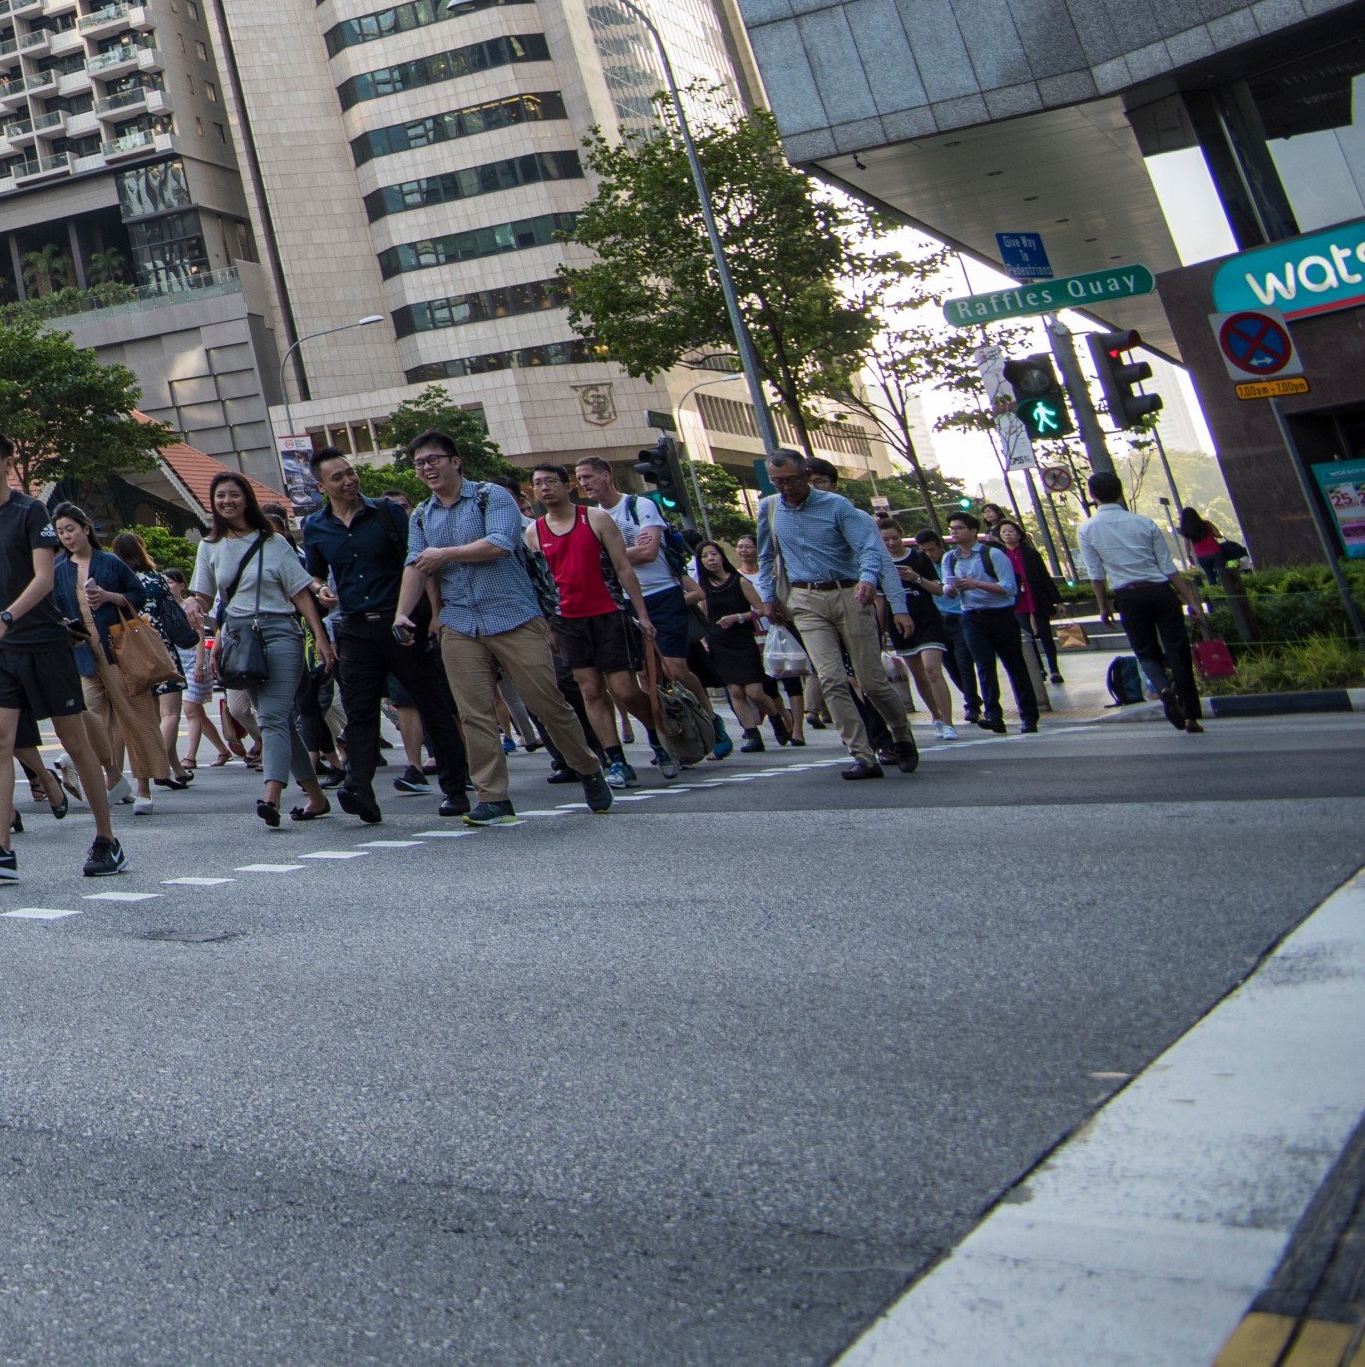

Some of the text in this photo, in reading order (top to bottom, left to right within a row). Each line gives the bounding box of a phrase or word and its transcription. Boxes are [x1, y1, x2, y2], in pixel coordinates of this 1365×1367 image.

[1003, 235, 1037, 250] Give Way
[1019, 250, 1028, 262] To
[1007, 264, 1053, 276] Pedestrians
[957, 274, 1136, 319] Raffles Quay
[1239, 386, 1269, 397] 7.00am
[1276, 381, 1306, 393] 7.00pm
[1331, 492, 1353, 508] 25
